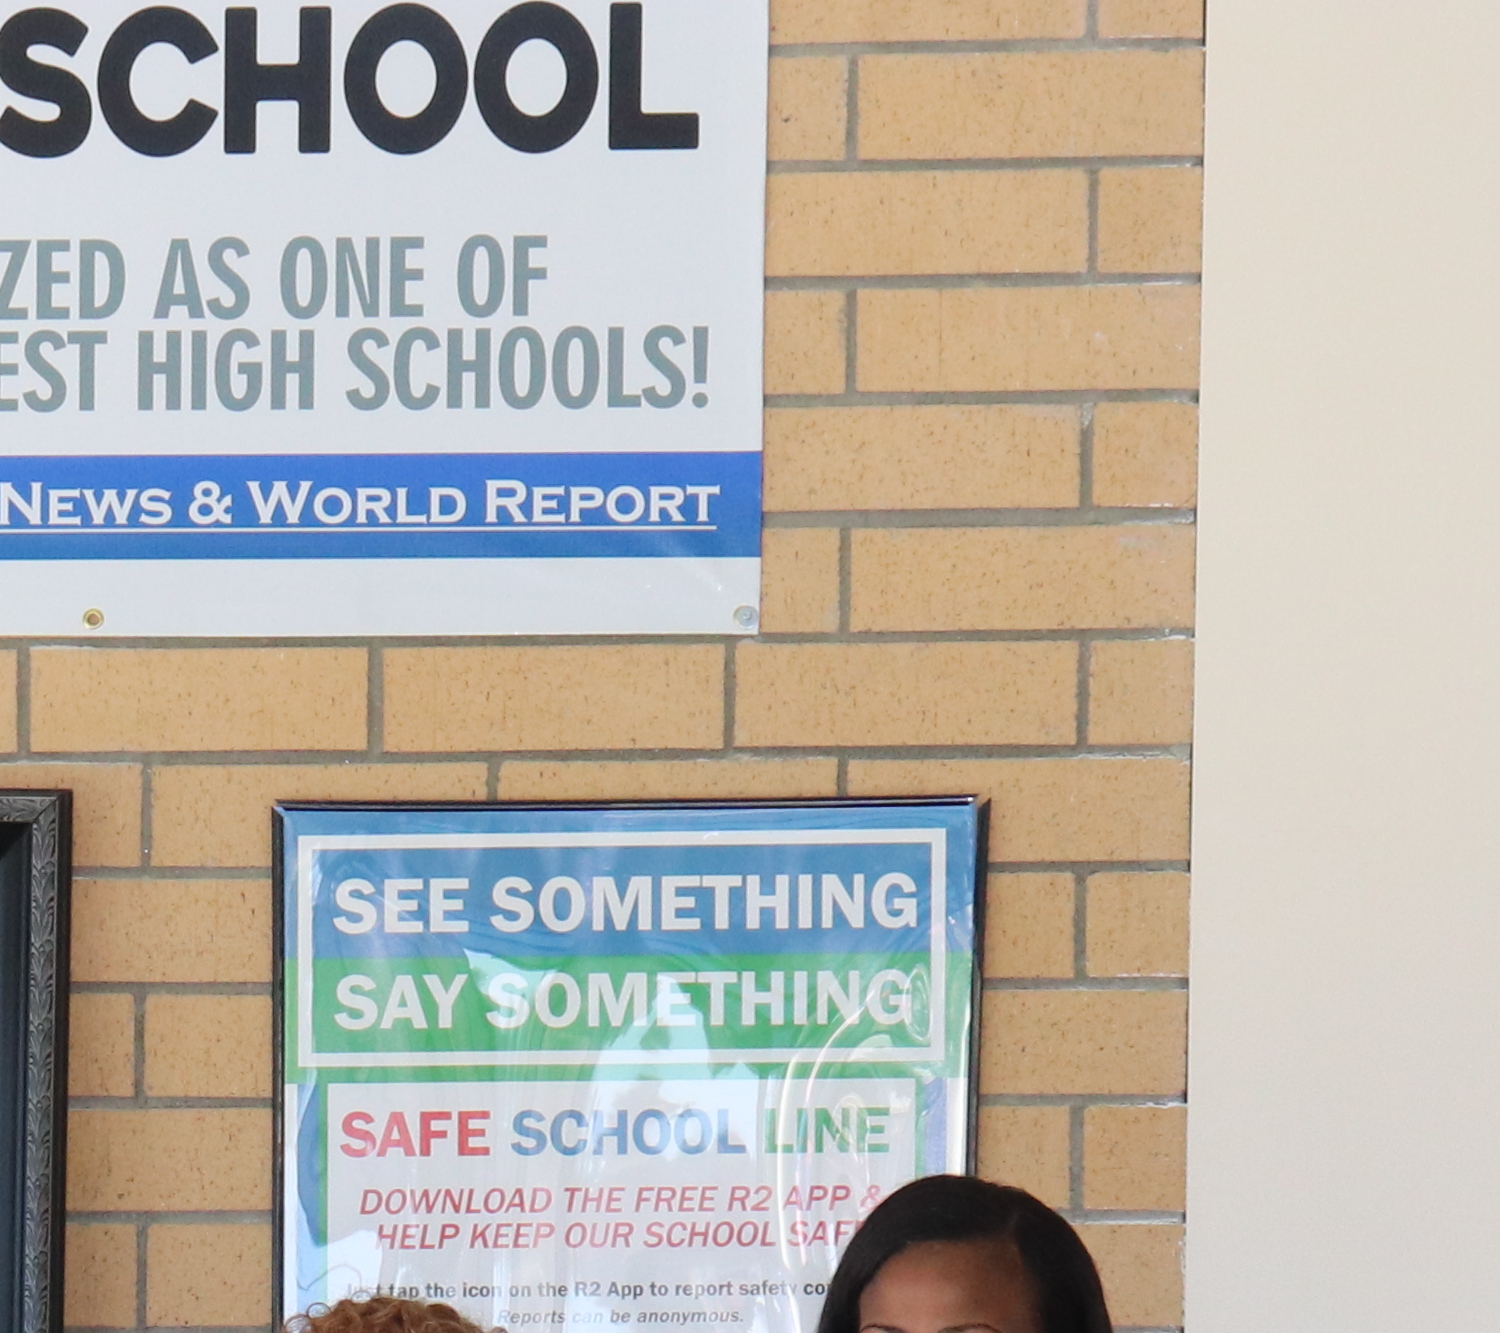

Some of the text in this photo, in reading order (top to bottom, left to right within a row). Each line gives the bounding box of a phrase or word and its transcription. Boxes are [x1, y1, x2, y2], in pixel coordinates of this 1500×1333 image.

[153, 238, 251, 323] AS
[278, 235, 426, 319] ONE
[456, 234, 550, 318] OF
[136, 328, 315, 412] HIGH
[344, 326, 712, 412] SCHOOLS!
[188, 483, 233, 527] &
[249, 482, 467, 527] WORLD
[483, 481, 721, 526] REPORT
[332, 872, 919, 934] SEE SOMETHING
[333, 968, 914, 1031] SAY SOMETHING
[339, 1106, 890, 1158] SAFE SCHOOL LINE
[358, 1187, 553, 1216] DOWNLOAD
[563, 1186, 626, 1213] THE
[634, 1185, 719, 1213] FREE
[726, 1185, 773, 1212] R2
[782, 1184, 853, 1211] APP
[377, 1222, 460, 1250] HELP
[468, 1222, 555, 1249] KEEP
[563, 1221, 635, 1249] OUR
[642, 1220, 777, 1248] SCHOOL
[388, 1283, 420, 1300] tap
[425, 1282, 457, 1298] the
[462, 1281, 502, 1298] icon
[508, 1284, 532, 1298] on
[537, 1281, 569, 1297] the
[574, 1281, 601, 1297] R2
[606, 1281, 644, 1300] App
[650, 1281, 669, 1297] to
[674, 1281, 734, 1300] report
[738, 1280, 798, 1299] safety
[499, 1308, 744, 1326] Reports can be anonymous.
